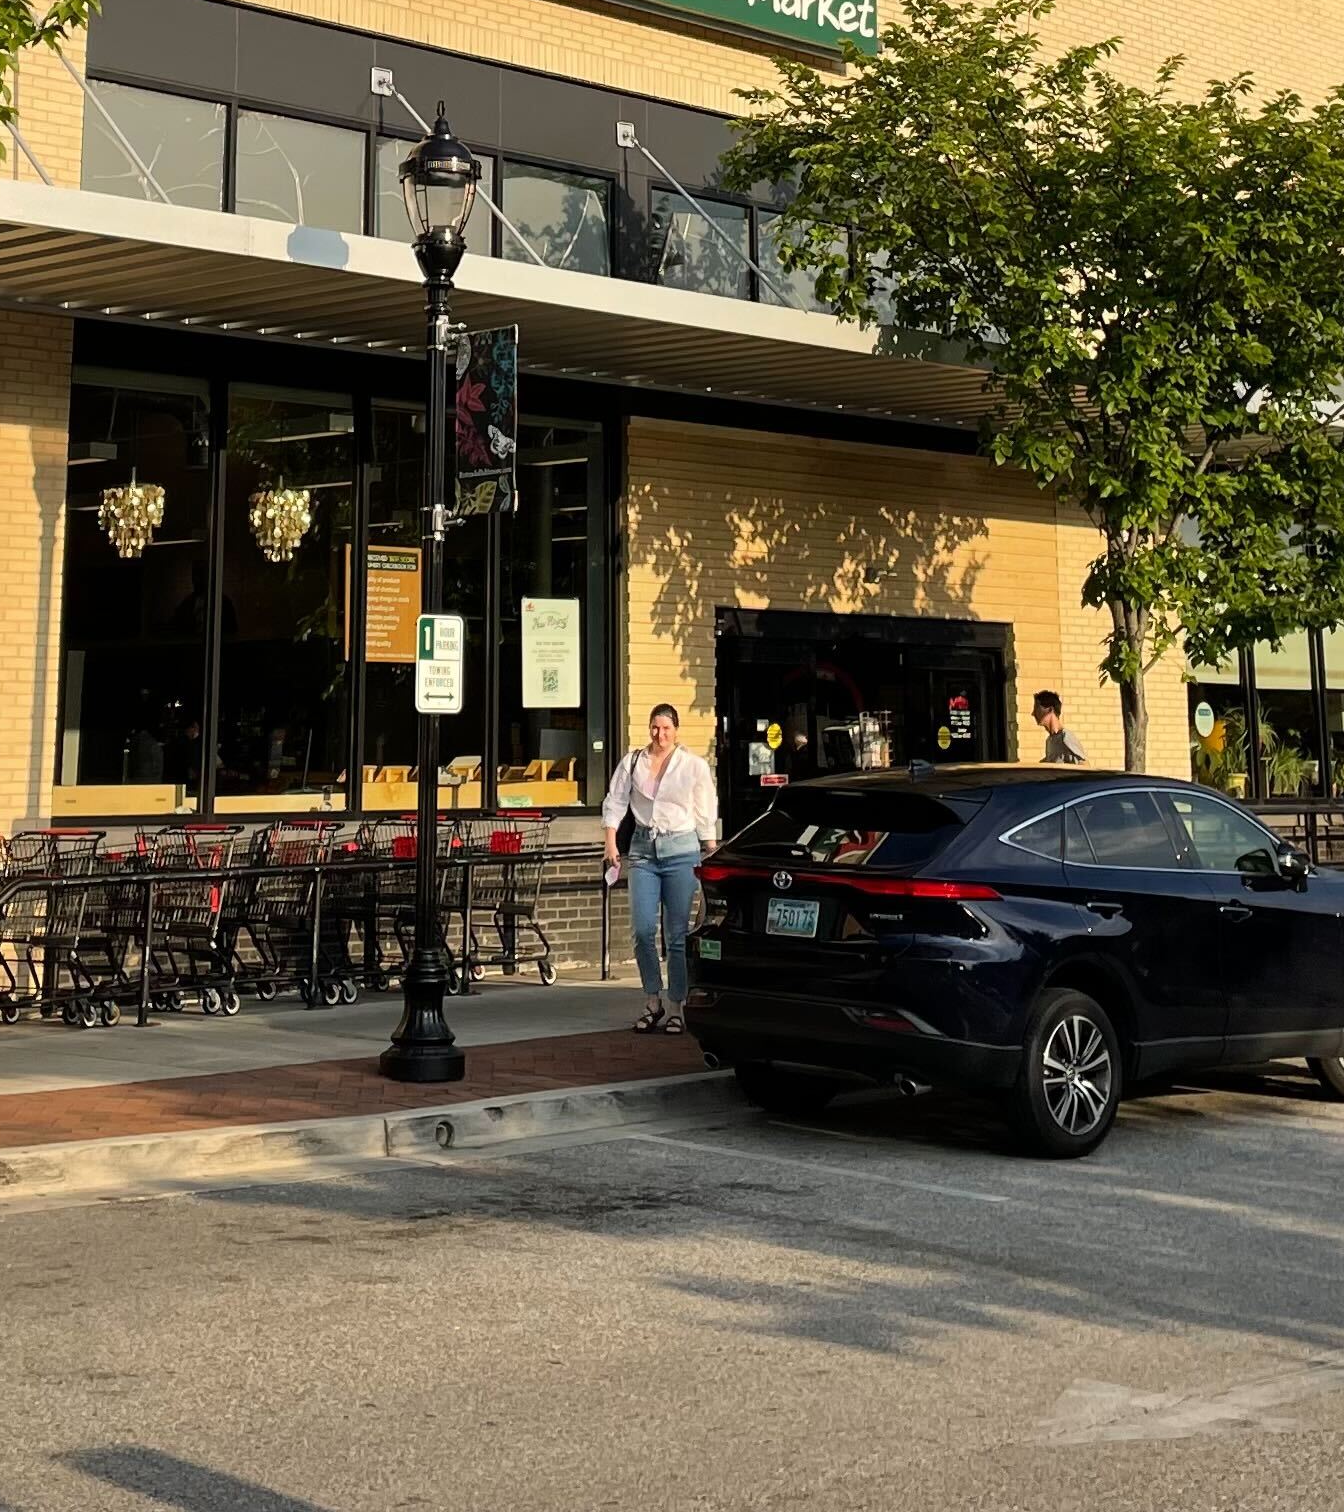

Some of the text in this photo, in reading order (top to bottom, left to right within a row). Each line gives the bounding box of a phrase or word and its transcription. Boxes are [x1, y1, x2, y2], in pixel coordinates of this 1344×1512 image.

[439, 627, 455, 638] HOUR
[424, 626, 431, 651] 1
[435, 639, 459, 651] PARKING
[429, 666, 452, 676] TOWING
[424, 677, 454, 688] ENFORCED
